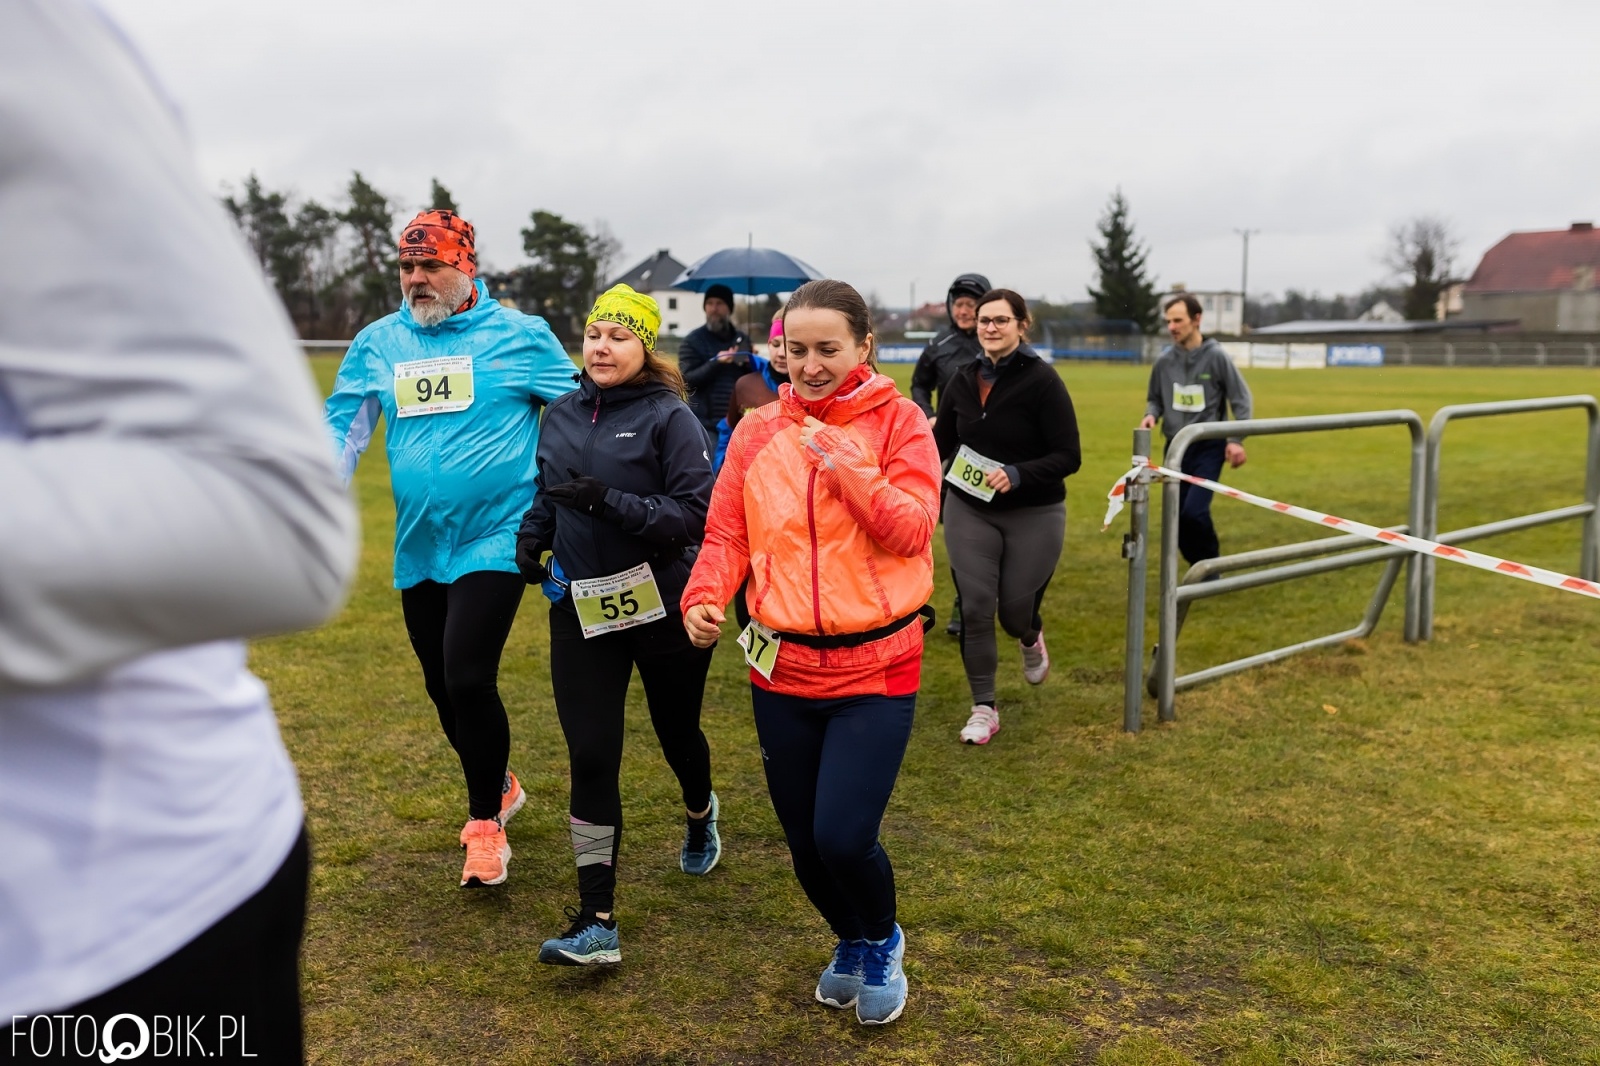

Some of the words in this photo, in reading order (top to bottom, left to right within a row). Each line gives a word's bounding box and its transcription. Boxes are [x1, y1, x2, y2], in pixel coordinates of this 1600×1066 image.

[416, 375, 452, 402] 94
[962, 464, 984, 487] 89
[600, 589, 639, 620] 55
